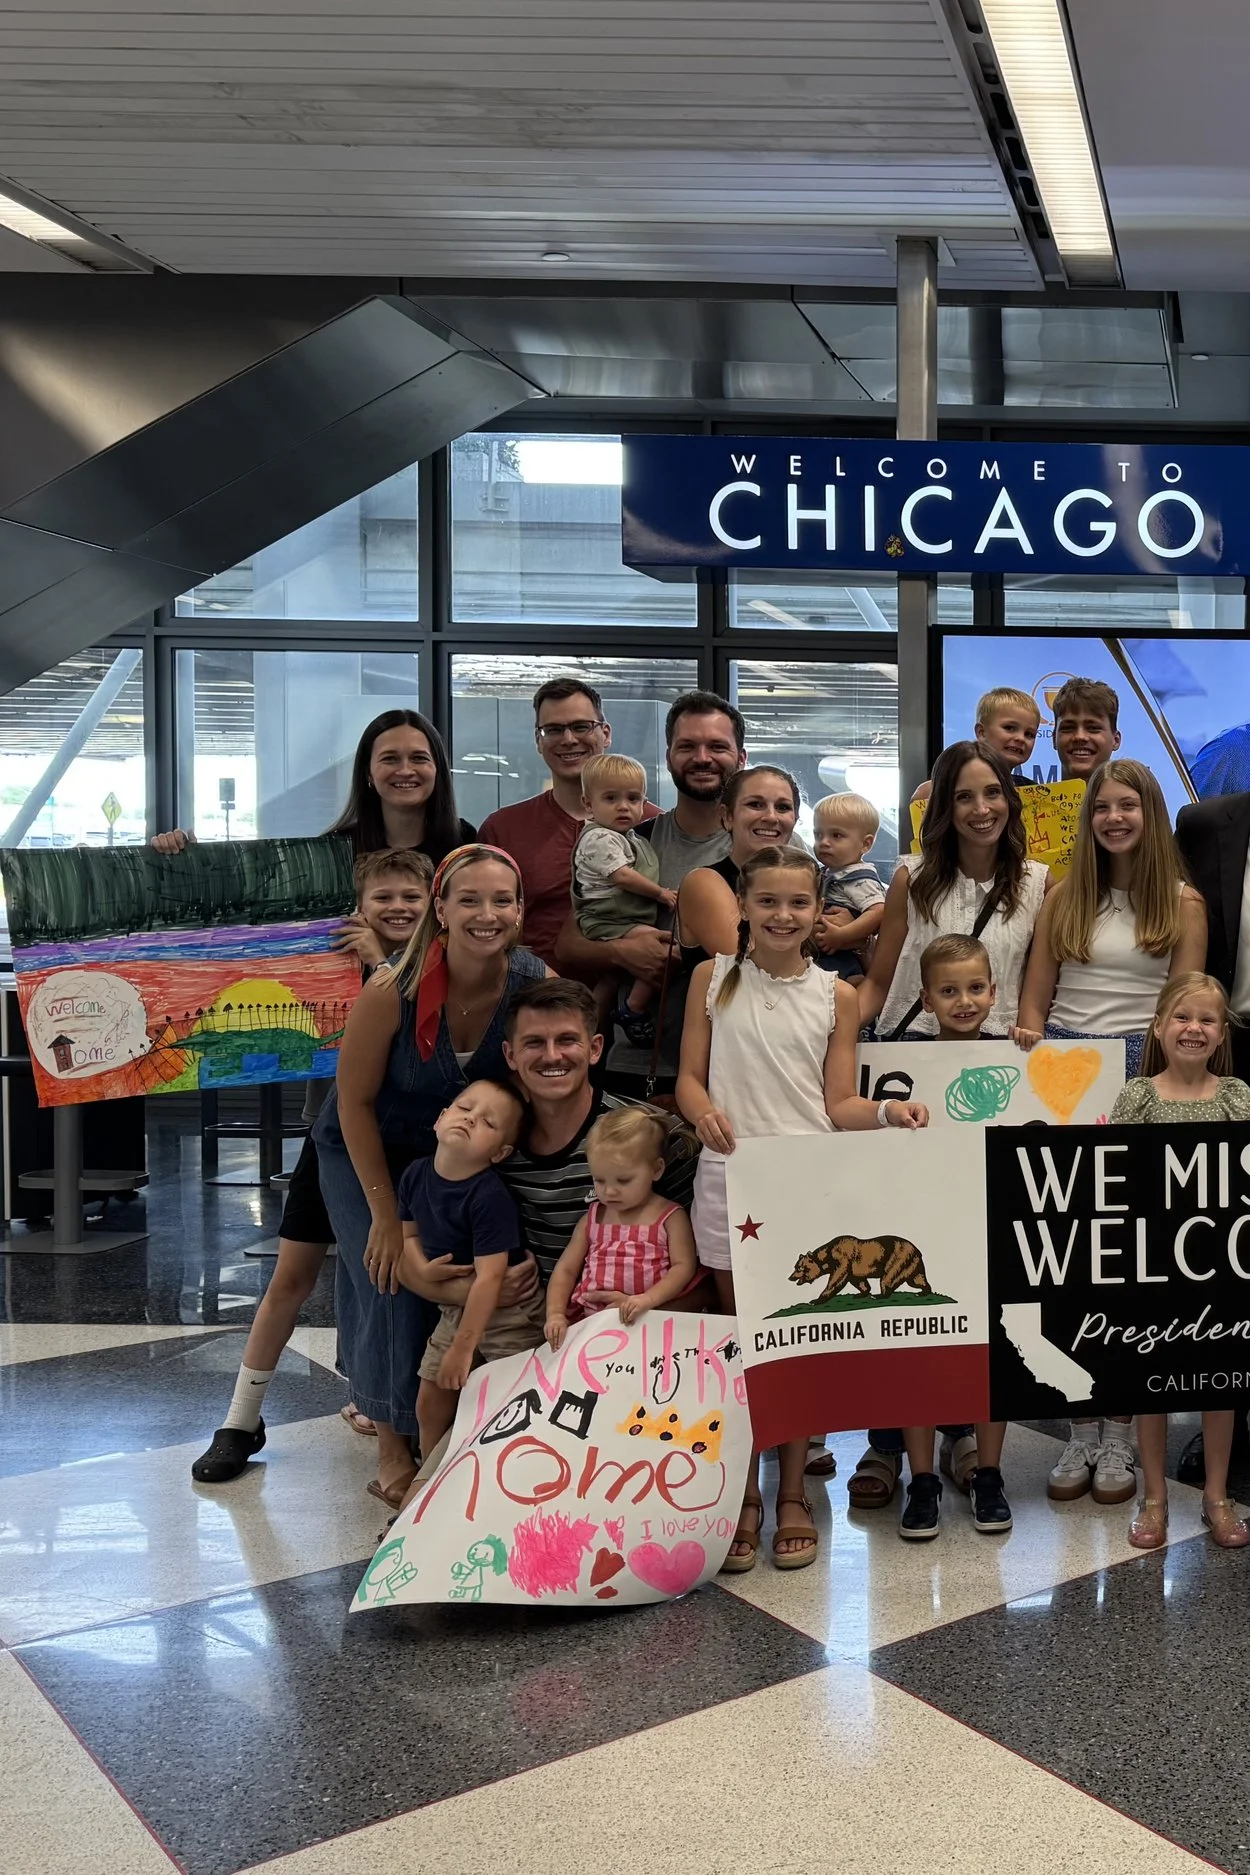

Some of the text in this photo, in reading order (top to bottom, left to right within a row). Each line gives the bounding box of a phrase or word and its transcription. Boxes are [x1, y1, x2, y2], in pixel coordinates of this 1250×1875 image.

[731, 453, 1183, 484] WELCOME TO
[708, 480, 1206, 559] CHICAGO
[1015, 1144, 1130, 1214] WE
[754, 1320, 865, 1353] CALIFORNIA
[880, 1315, 969, 1338] REPUBLIC
[640, 1519, 653, 1541] I
[660, 1516, 701, 1537] love
